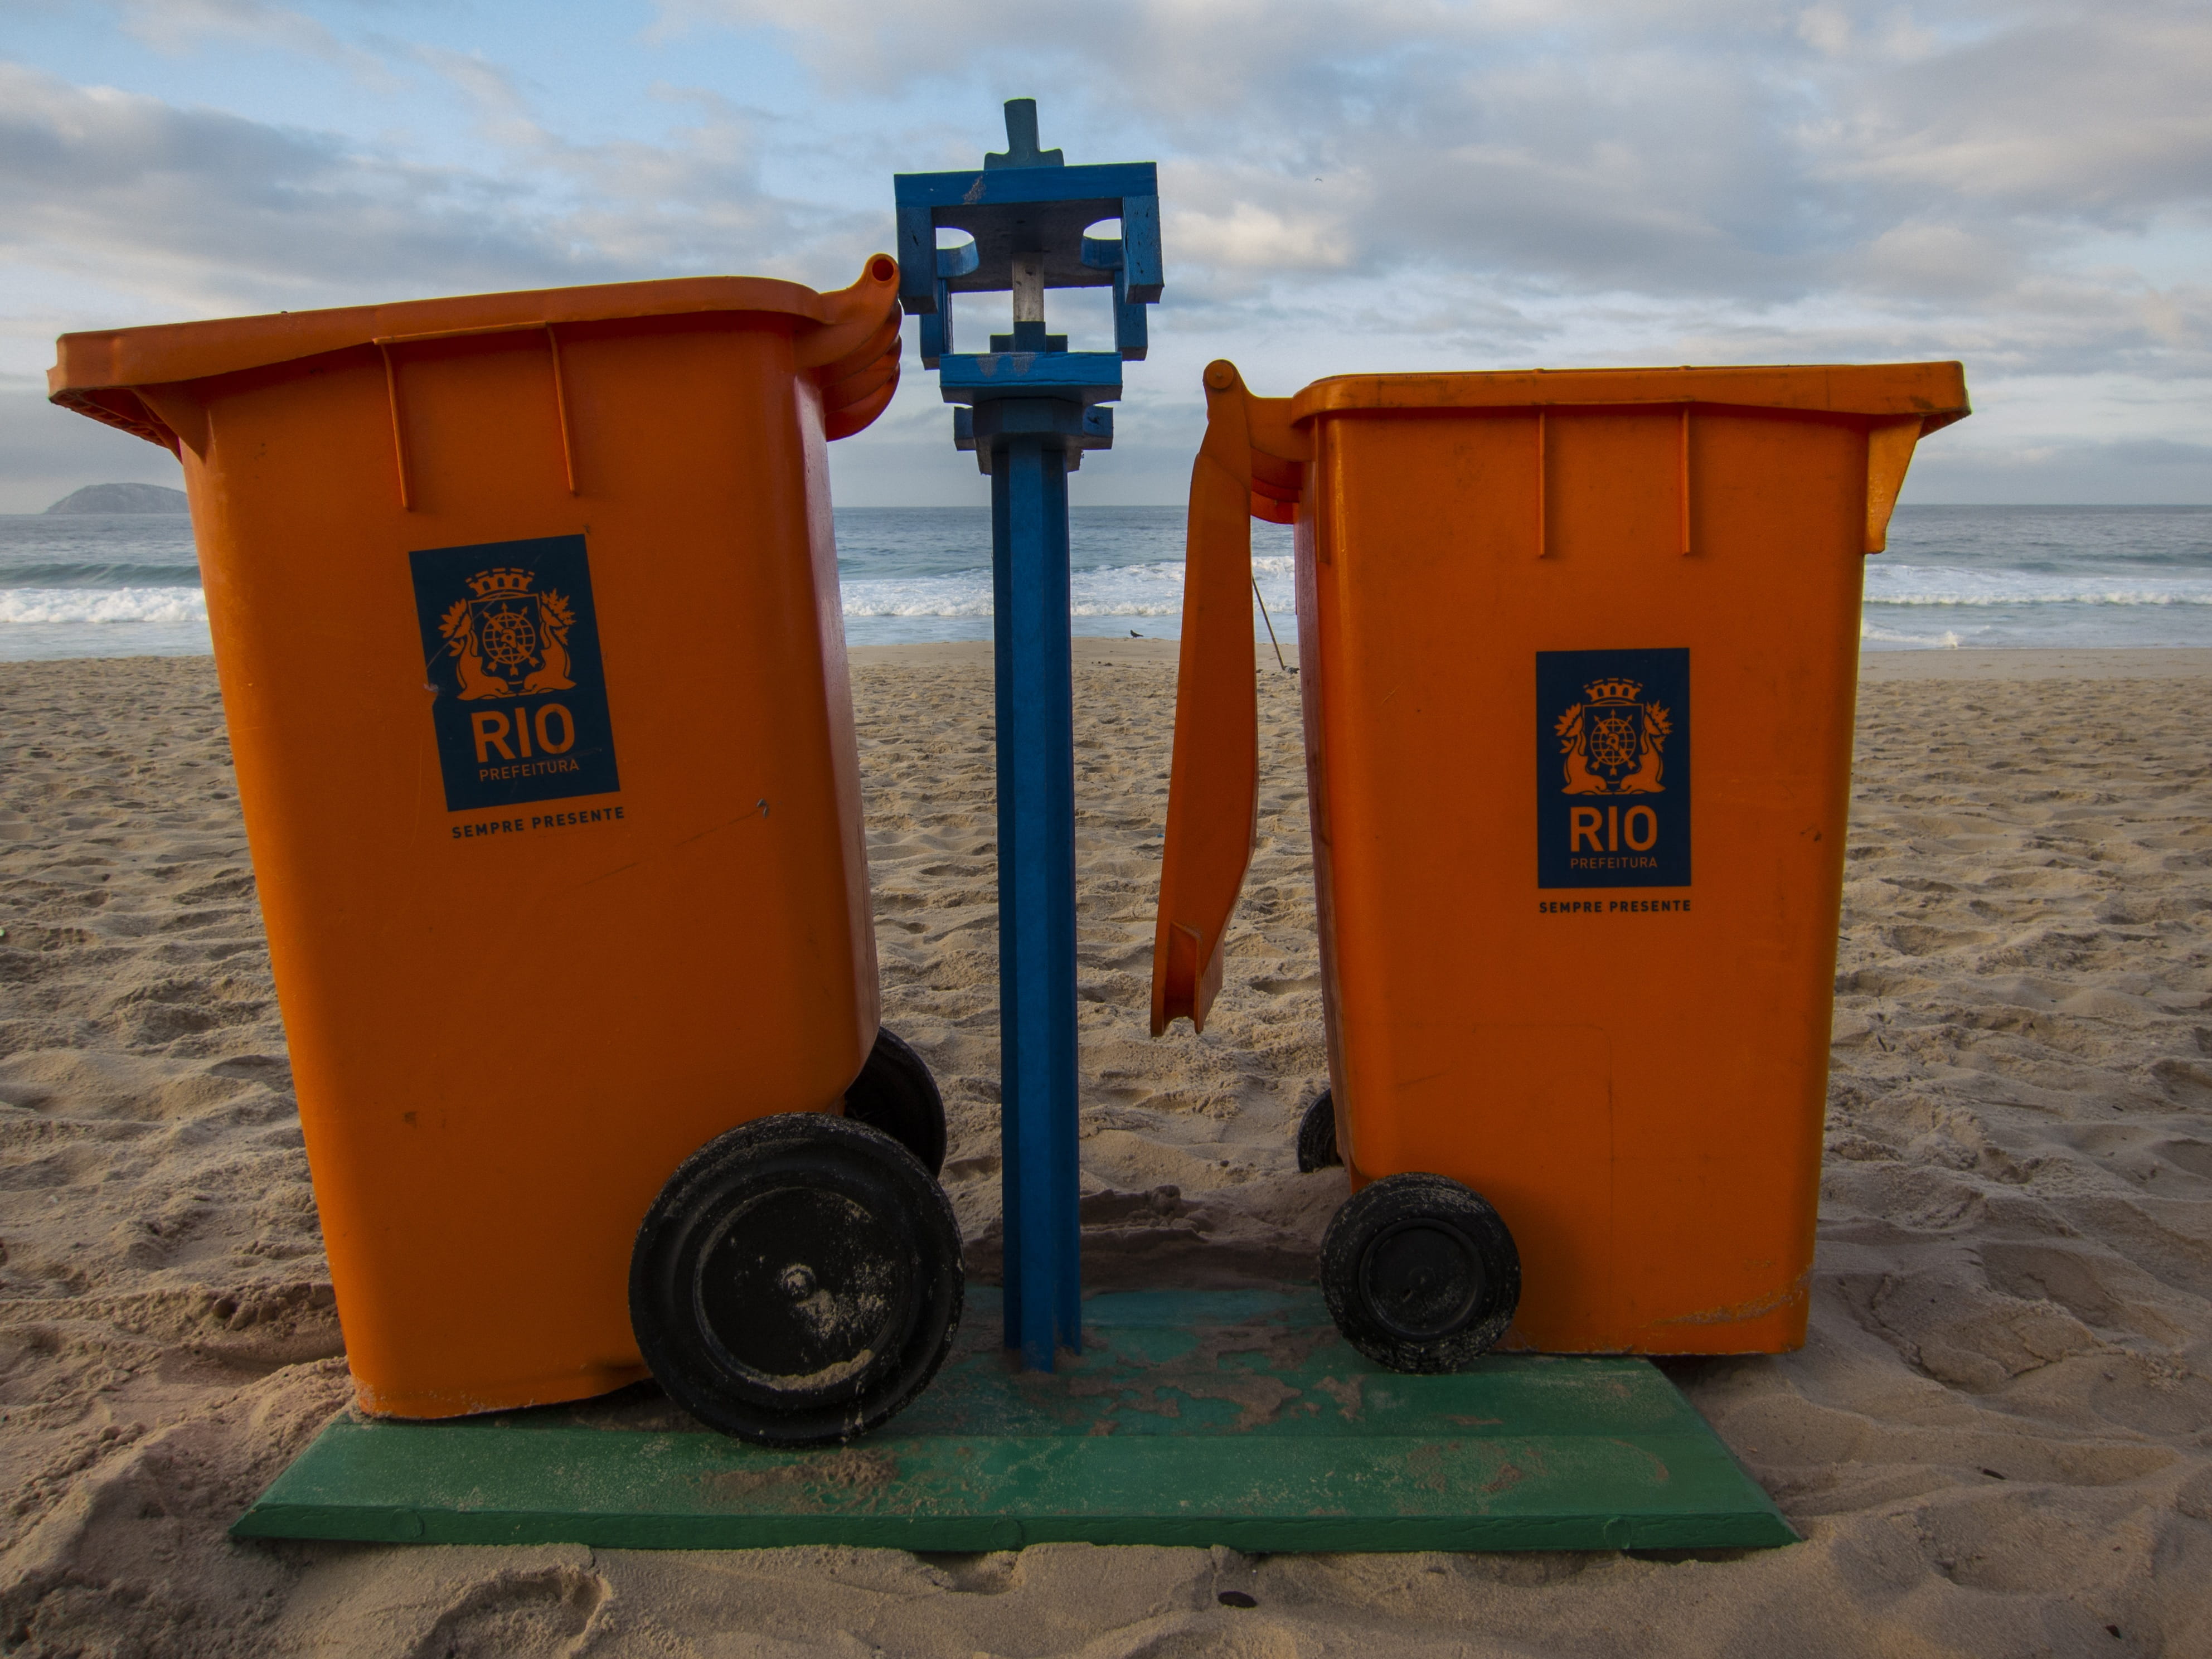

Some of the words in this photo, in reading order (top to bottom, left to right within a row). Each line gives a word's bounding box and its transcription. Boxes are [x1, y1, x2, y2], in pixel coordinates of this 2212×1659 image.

[471, 704, 574, 763] RIO
[479, 758, 579, 782] PREFEITURA
[452, 818, 524, 838] SEMPRE
[532, 807, 624, 829] PRESENTE
[1570, 805, 1658, 852] RIO
[1571, 857, 1658, 869] PREFEITURA
[1539, 901, 1602, 913] SEMPRE
[1610, 900, 1691, 912] PRESENTE
